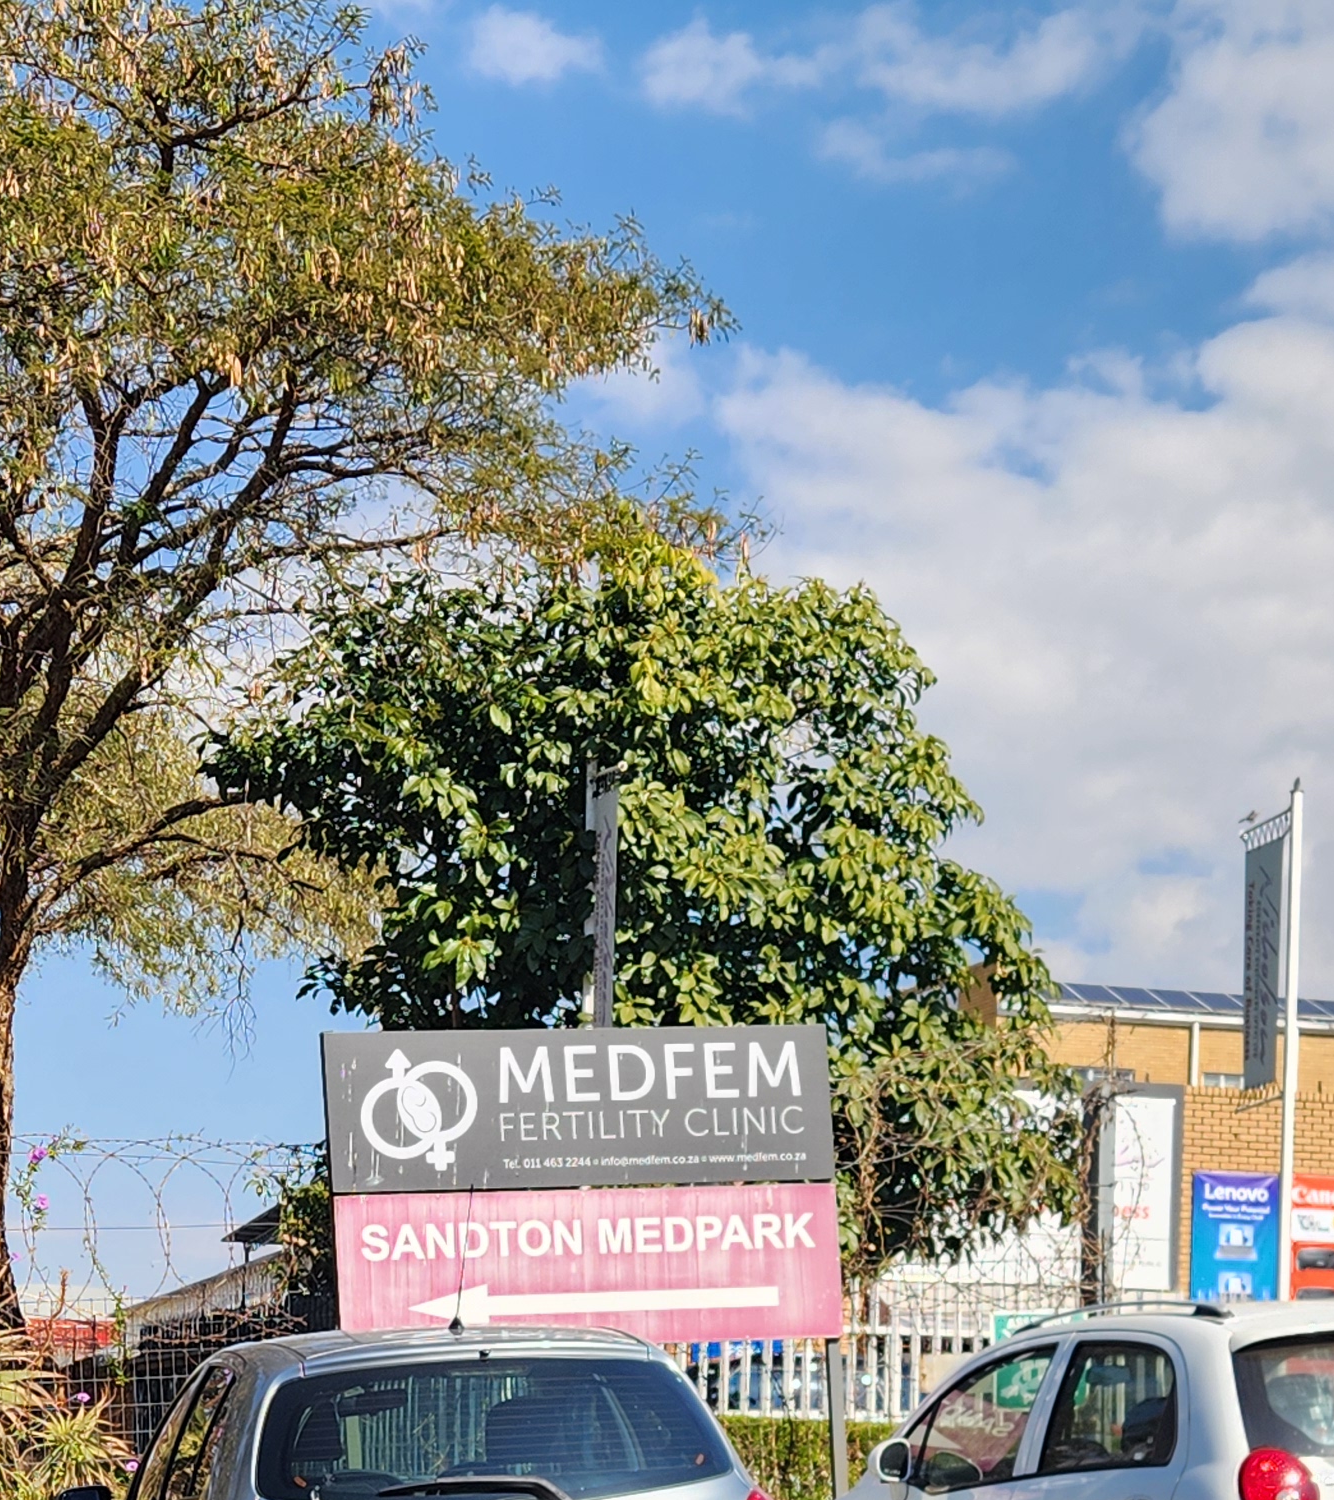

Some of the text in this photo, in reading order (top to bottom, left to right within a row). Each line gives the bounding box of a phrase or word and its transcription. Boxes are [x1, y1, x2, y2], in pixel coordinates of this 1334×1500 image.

[499, 1040, 803, 1104] MEDFEM
[499, 1105, 806, 1141] FERTILITY CLINIC
[523, 1158, 542, 1169] 011
[543, 1156, 564, 1168] 463
[566, 1156, 592, 1168] 2244
[600, 1153, 700, 1167] info@medfem.co.za
[708, 1151, 807, 1164] www.medfem.co.za
[1204, 1183, 1269, 1203] Lenovo
[360, 1212, 817, 1262] SANDTON MEDPARK
